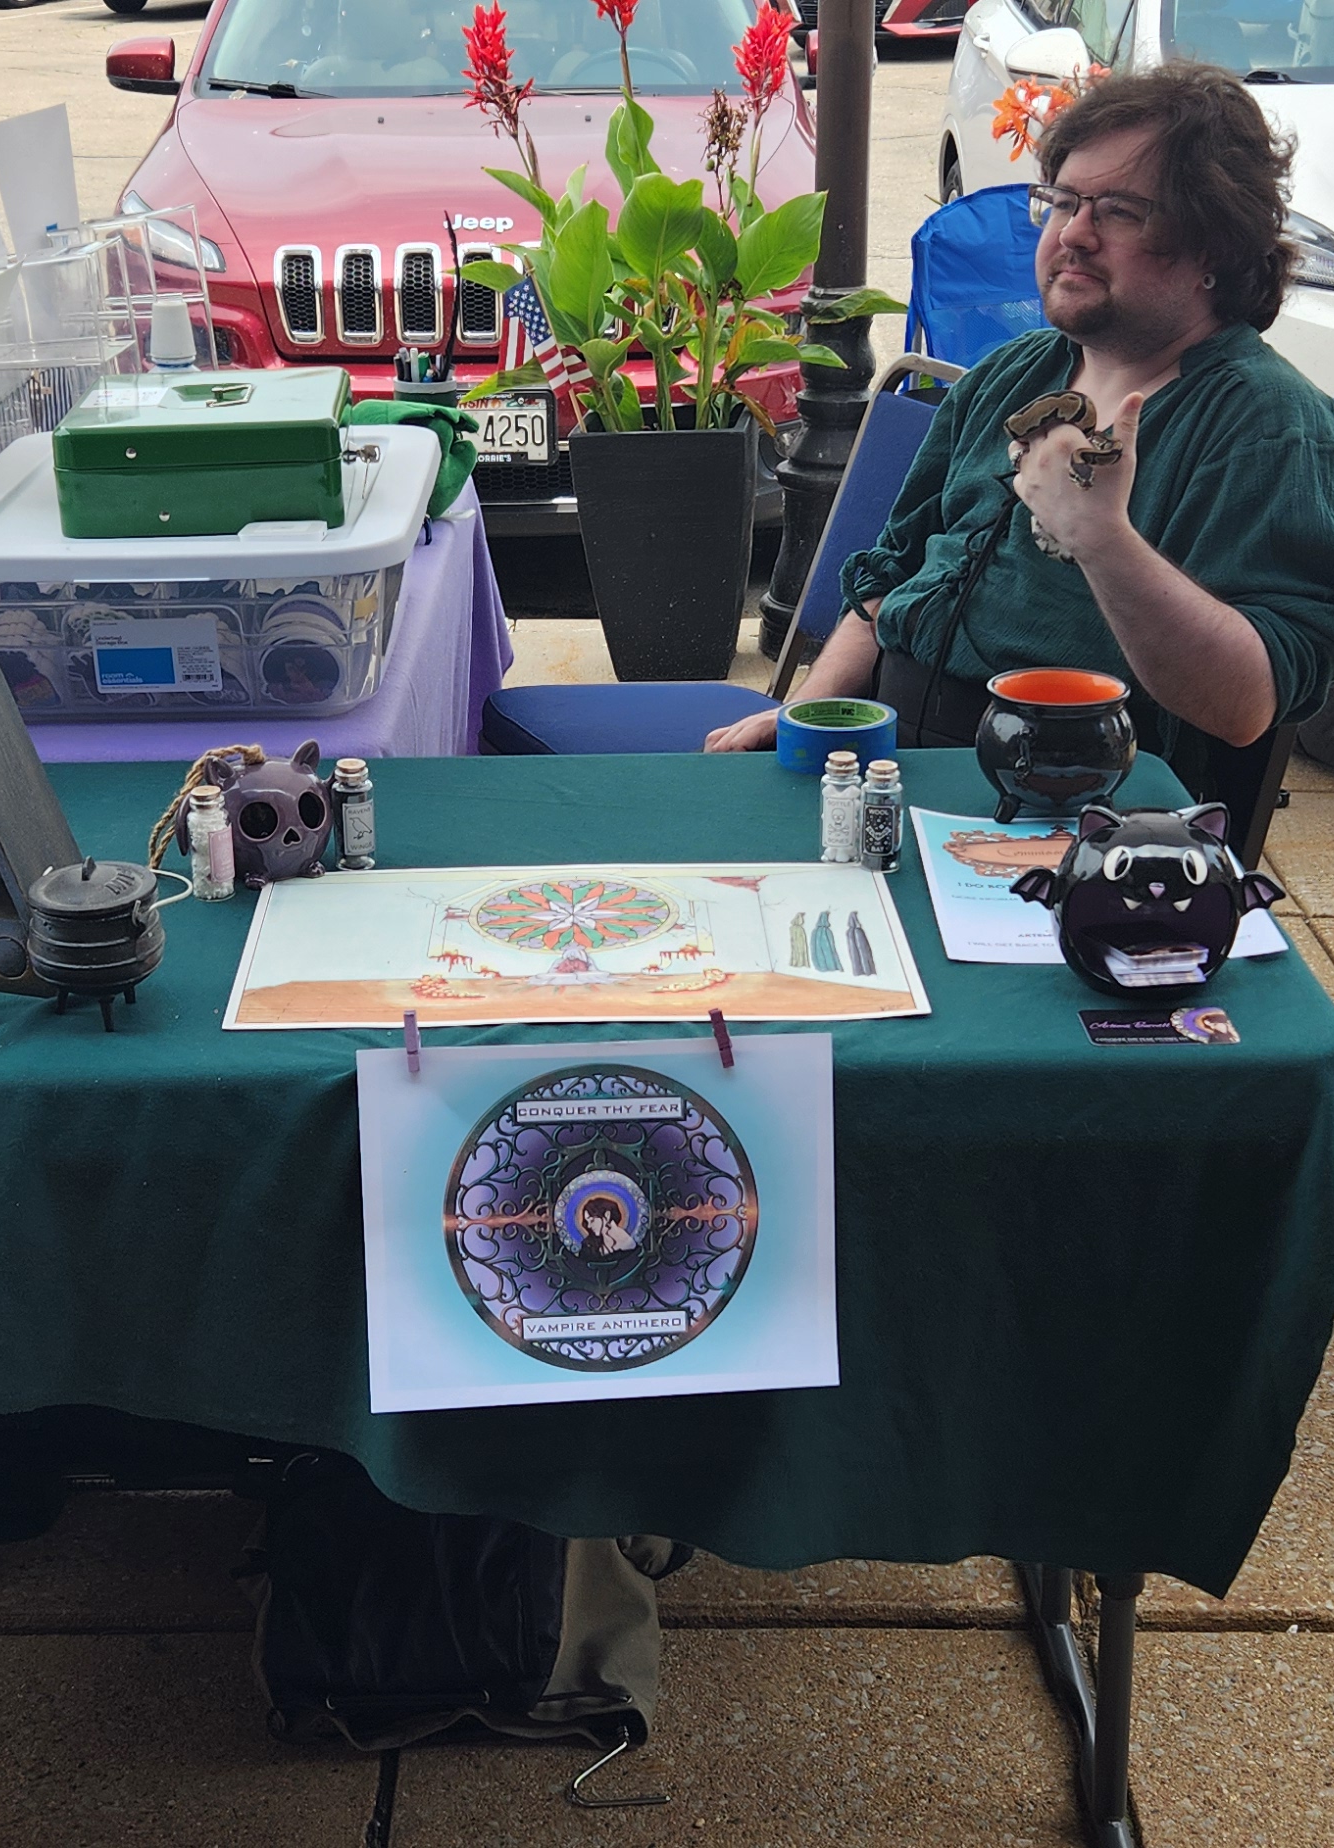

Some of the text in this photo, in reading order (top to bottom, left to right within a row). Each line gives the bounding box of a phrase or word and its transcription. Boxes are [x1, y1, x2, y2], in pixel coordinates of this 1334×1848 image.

[443, 213, 514, 234] Jeep
[483, 414, 545, 447] 4250
[475, 454, 512, 463] ORRIE'S
[101, 676, 144, 685] essentials
[868, 808, 889, 816] WOOL
[517, 1103, 680, 1118] CONQUER THY FEAR
[527, 1317, 683, 1334] VAMPIRE ANTIHERO
